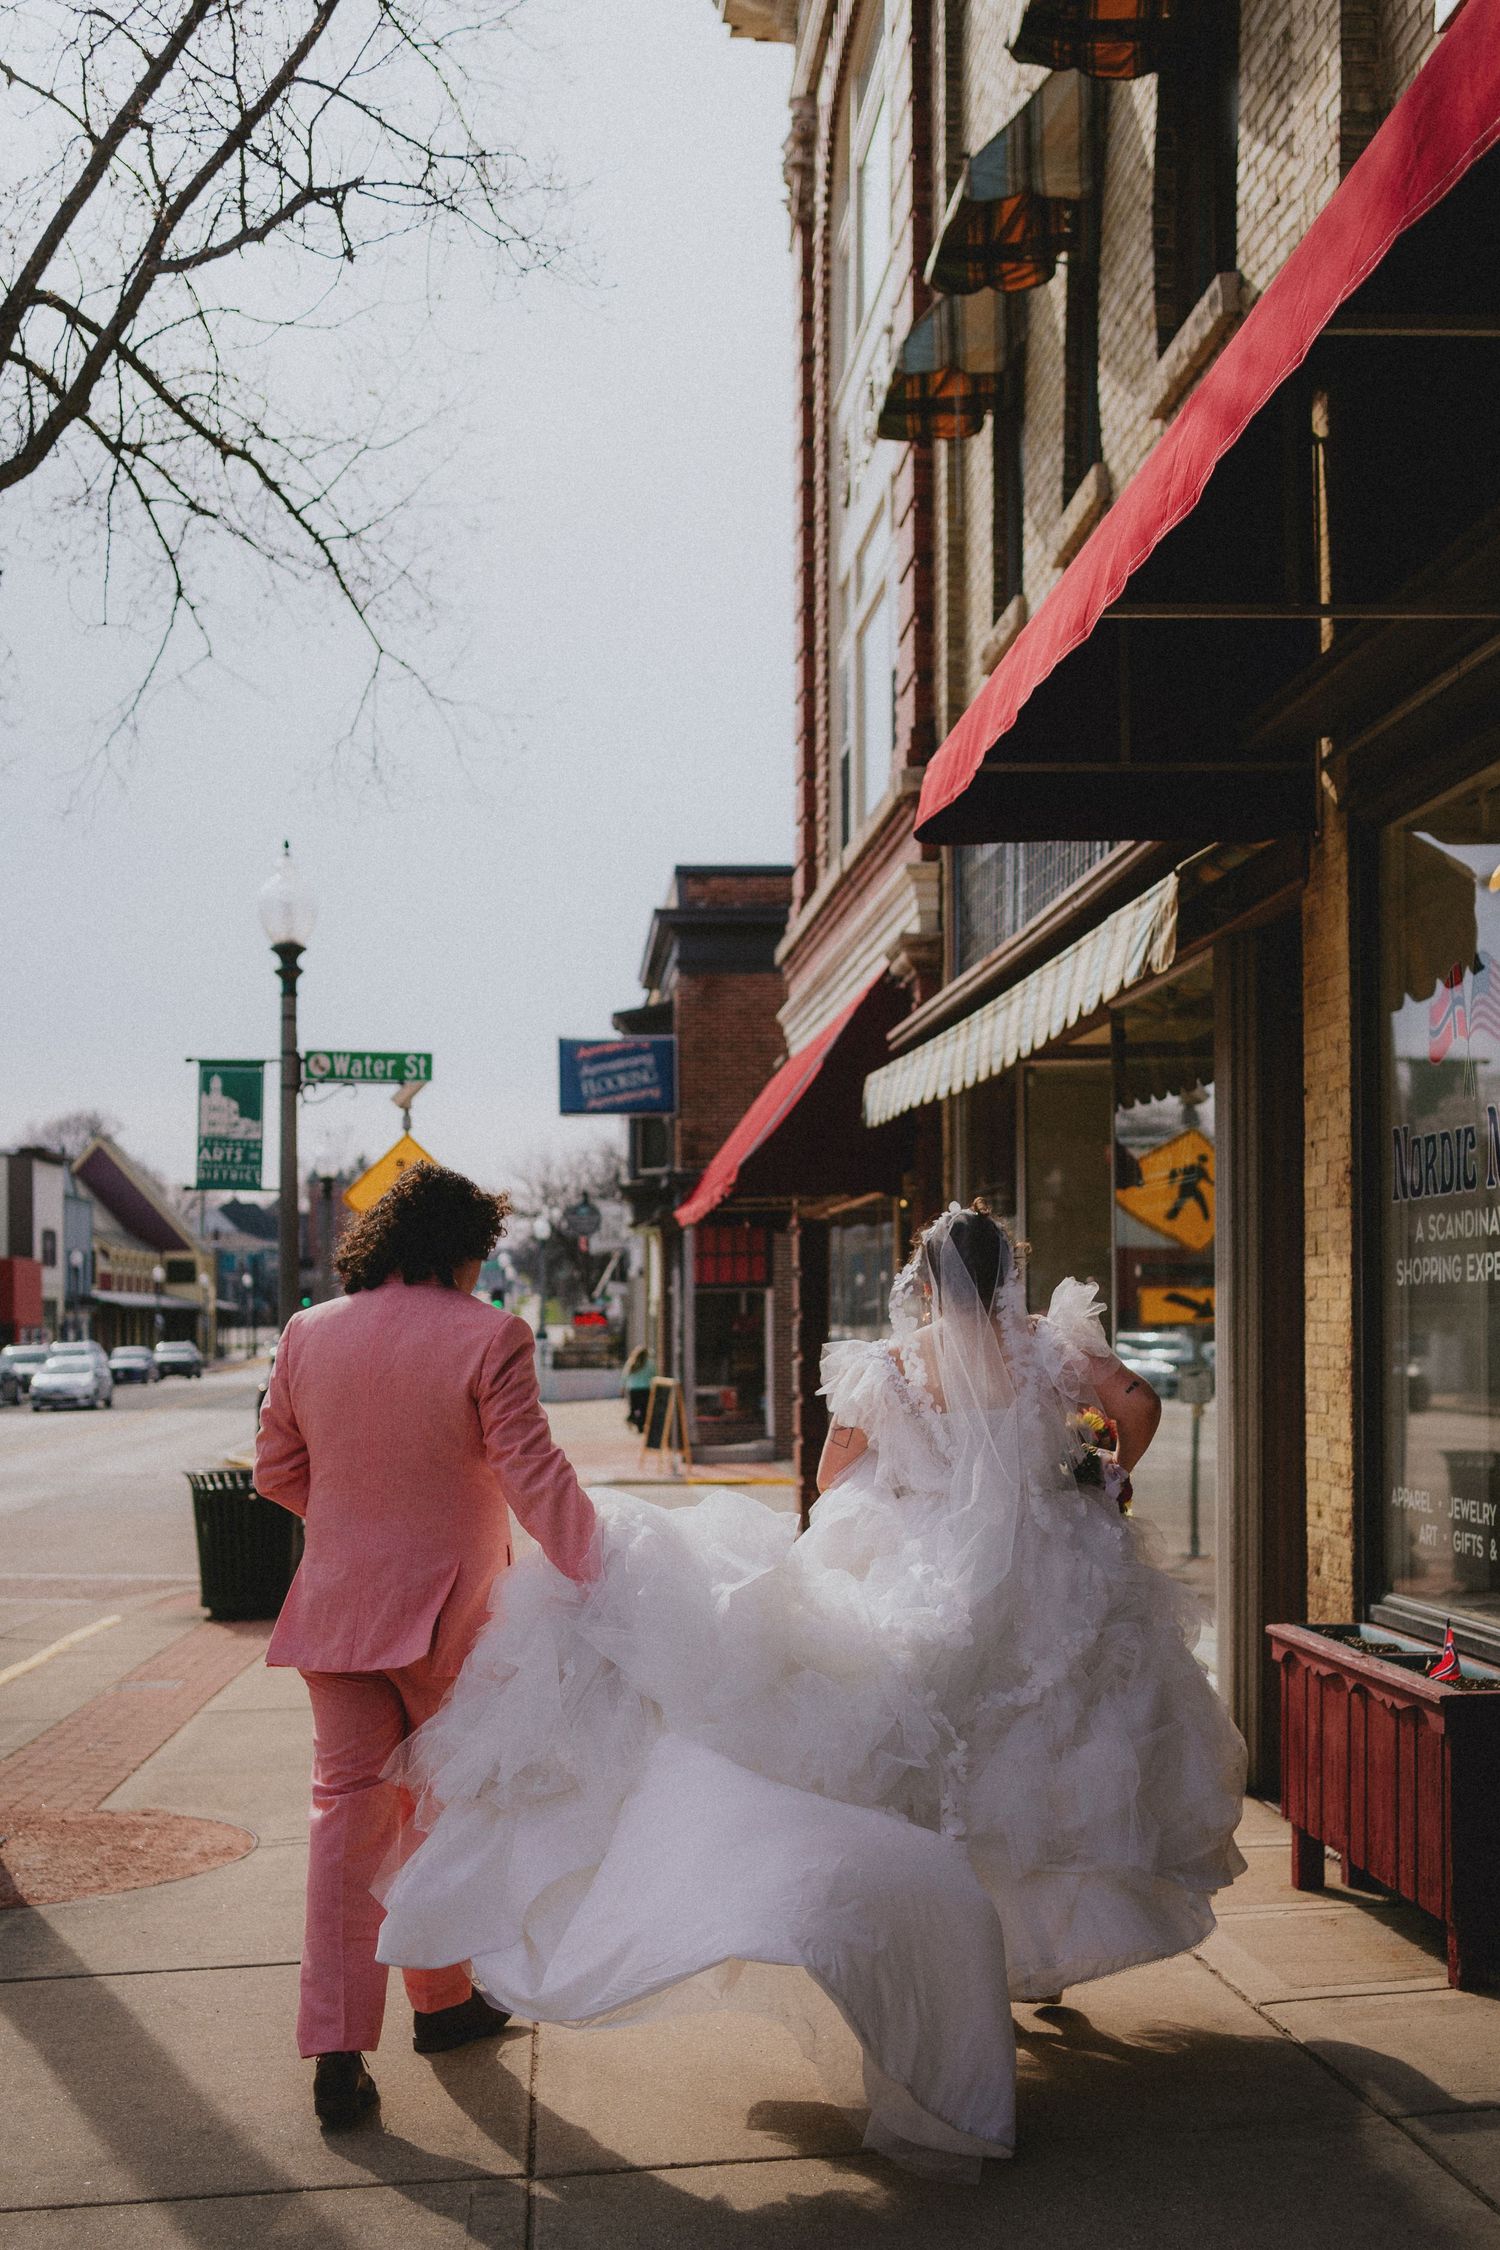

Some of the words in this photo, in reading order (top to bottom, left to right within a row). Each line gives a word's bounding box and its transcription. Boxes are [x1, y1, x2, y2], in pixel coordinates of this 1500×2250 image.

[333, 1053, 396, 1078] Water
[404, 1055, 425, 1079] St
[199, 1146, 243, 1163] ARTS
[1391, 1123, 1477, 1203] NORDIC
[1415, 1217, 1425, 1243] A
[1396, 1254, 1462, 1286] SHOPPING
[1392, 1487, 1433, 1513] APPAREL
[1448, 1497, 1497, 1526] JEWELRY
[1419, 1524, 1438, 1546] ART
[1453, 1530, 1484, 1558] GIFTS
[1490, 1538, 1497, 1560] &
